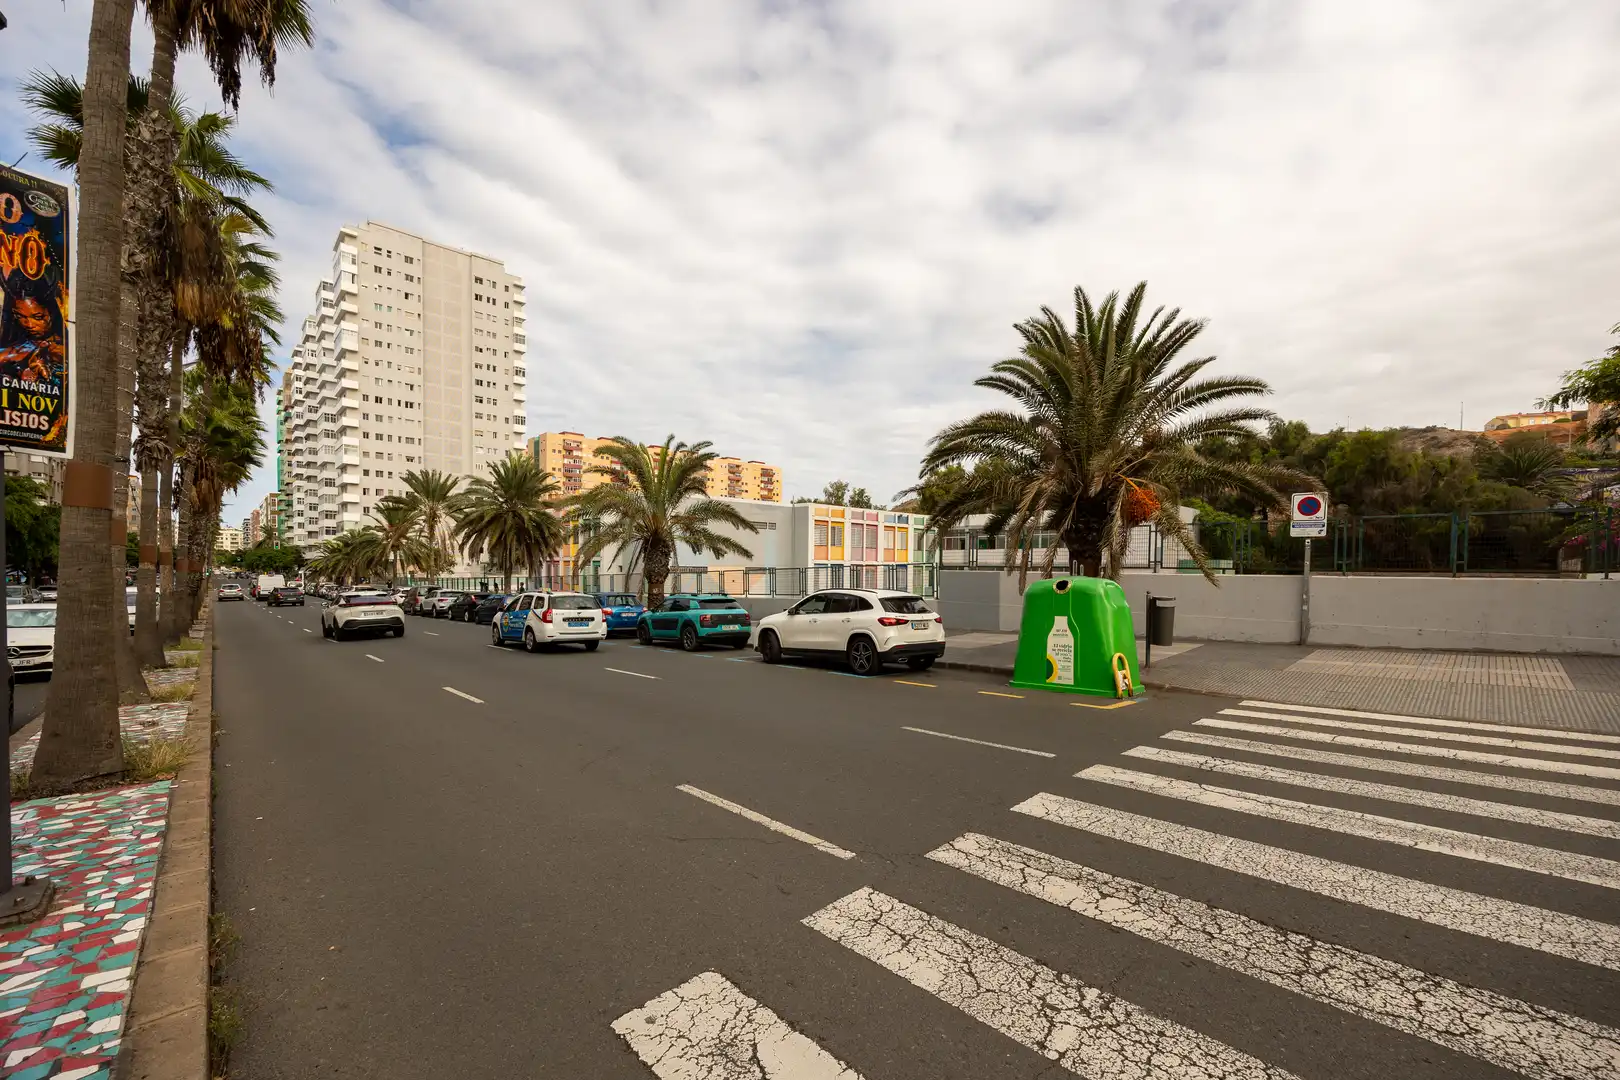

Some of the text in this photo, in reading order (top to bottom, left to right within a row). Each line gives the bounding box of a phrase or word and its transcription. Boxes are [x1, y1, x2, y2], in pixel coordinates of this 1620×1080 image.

[0, 170, 30, 186] OCURA
[2, 377, 60, 395] CANARIA
[17, 392, 59, 415] NOV
